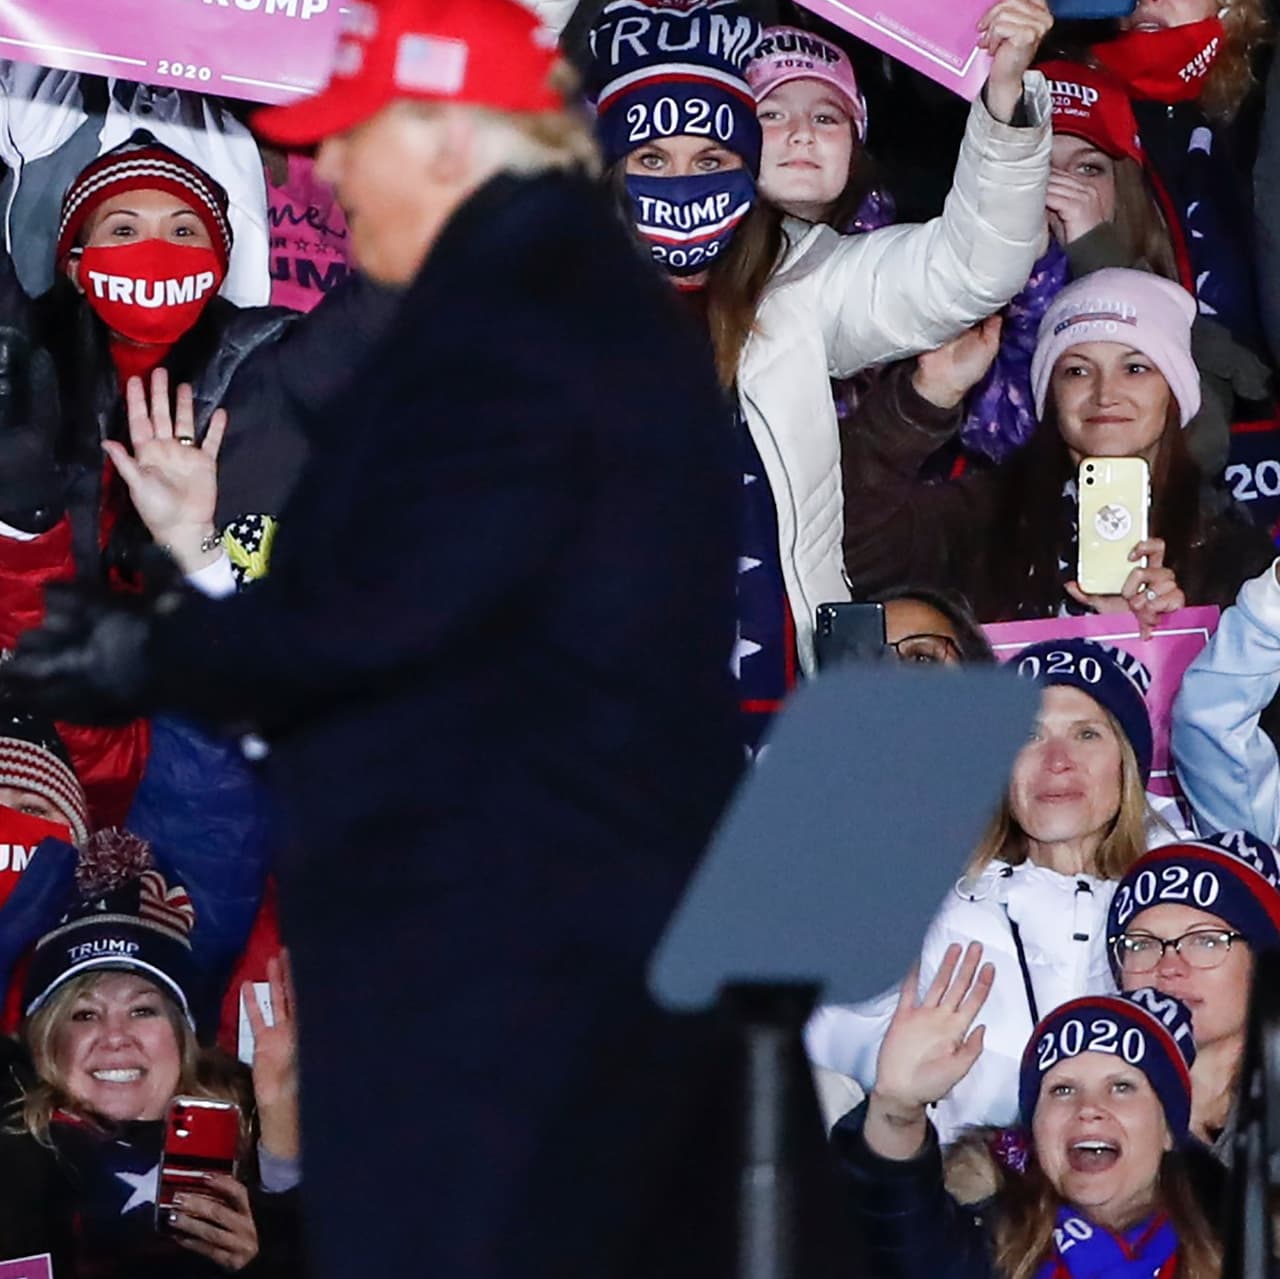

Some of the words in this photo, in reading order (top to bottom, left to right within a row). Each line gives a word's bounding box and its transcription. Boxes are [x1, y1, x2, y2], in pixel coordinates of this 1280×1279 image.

[755, 32, 842, 64] RUMP
[1178, 37, 1219, 78] TRUMP
[156, 59, 213, 83] 2020
[1048, 80, 1099, 107] ump
[1052, 96, 1072, 107] 20
[626, 96, 735, 141] 2020
[637, 192, 732, 229] TRUMP
[651, 241, 720, 267] 2020
[86, 269, 216, 309] TRUMP
[1115, 865, 1220, 925] 2020
[67, 939, 140, 959] TRUMP
[1037, 1018, 1146, 1072] 2020
